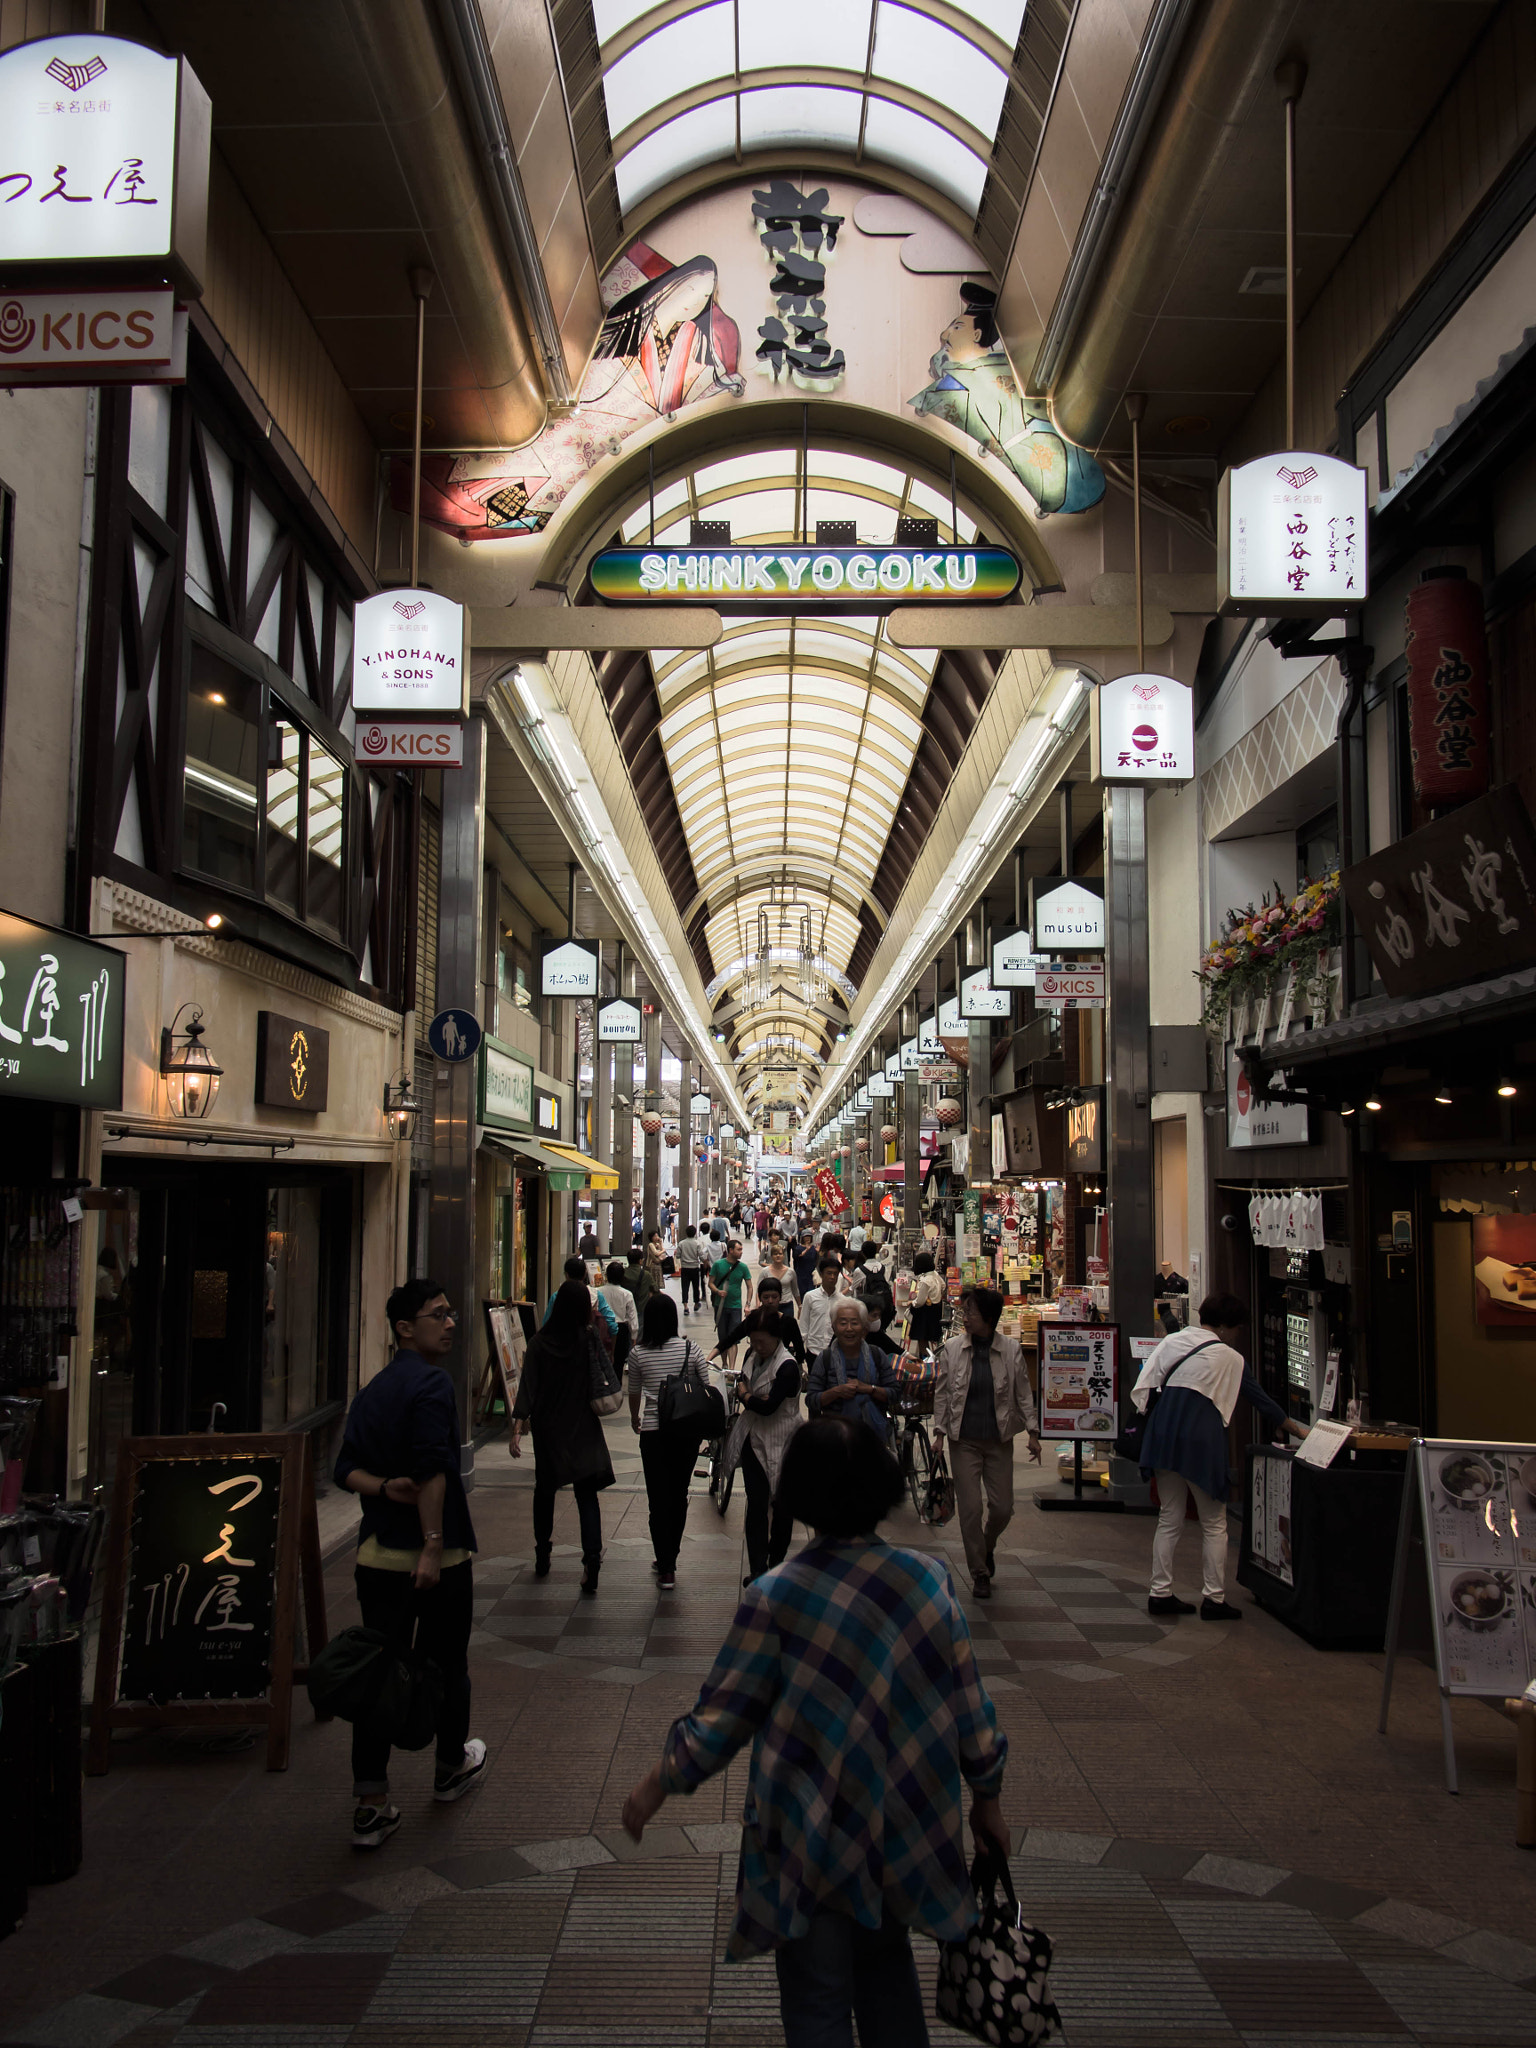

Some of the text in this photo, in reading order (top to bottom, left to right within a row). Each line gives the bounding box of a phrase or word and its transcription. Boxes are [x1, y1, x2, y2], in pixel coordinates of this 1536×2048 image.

[43, 311, 154, 352] KICS
[1286, 512, 1312, 591] 西谷堂
[638, 553, 977, 591] SHINKYOGOKU
[381, 669, 434, 680] & SONS
[1432, 646, 1478, 770] 西谷堂
[391, 733, 452, 755] KICS
[1116, 751, 1177, 768] 天下一品
[1044, 922, 1098, 933] musubi
[1060, 980, 1095, 993] KICS
[603, 1024, 636, 1034] DOUTOR
[965, 1199, 979, 1234] 宇治茶
[1088, 1331, 1111, 1340] 2016
[1087, 1341, 1112, 1406] 天下一品祭り
[193, 1474, 264, 1632] つえ屋
